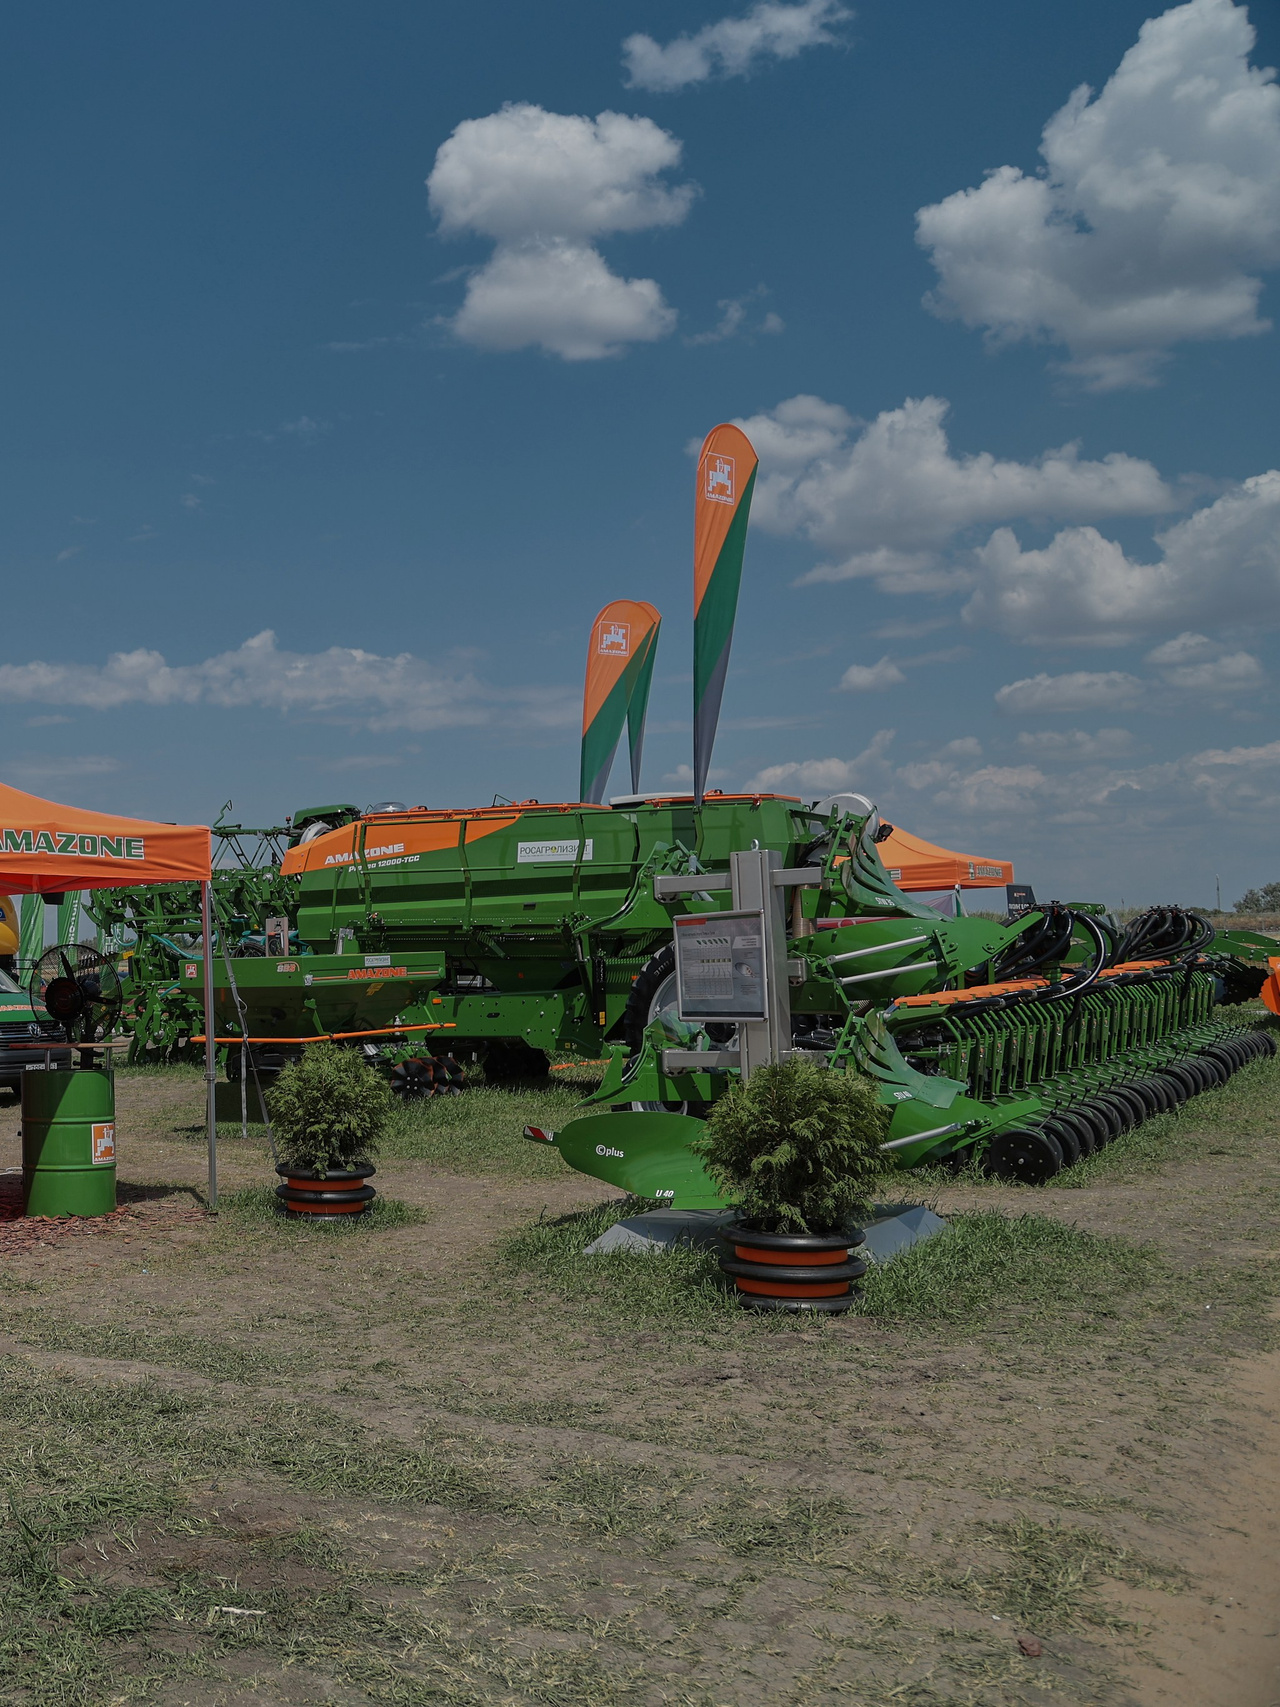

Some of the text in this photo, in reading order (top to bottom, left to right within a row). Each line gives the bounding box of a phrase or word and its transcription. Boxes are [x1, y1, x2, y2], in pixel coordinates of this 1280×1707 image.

[347, 966, 408, 980] AMAZONE
[655, 1189, 675, 1198] U 40
